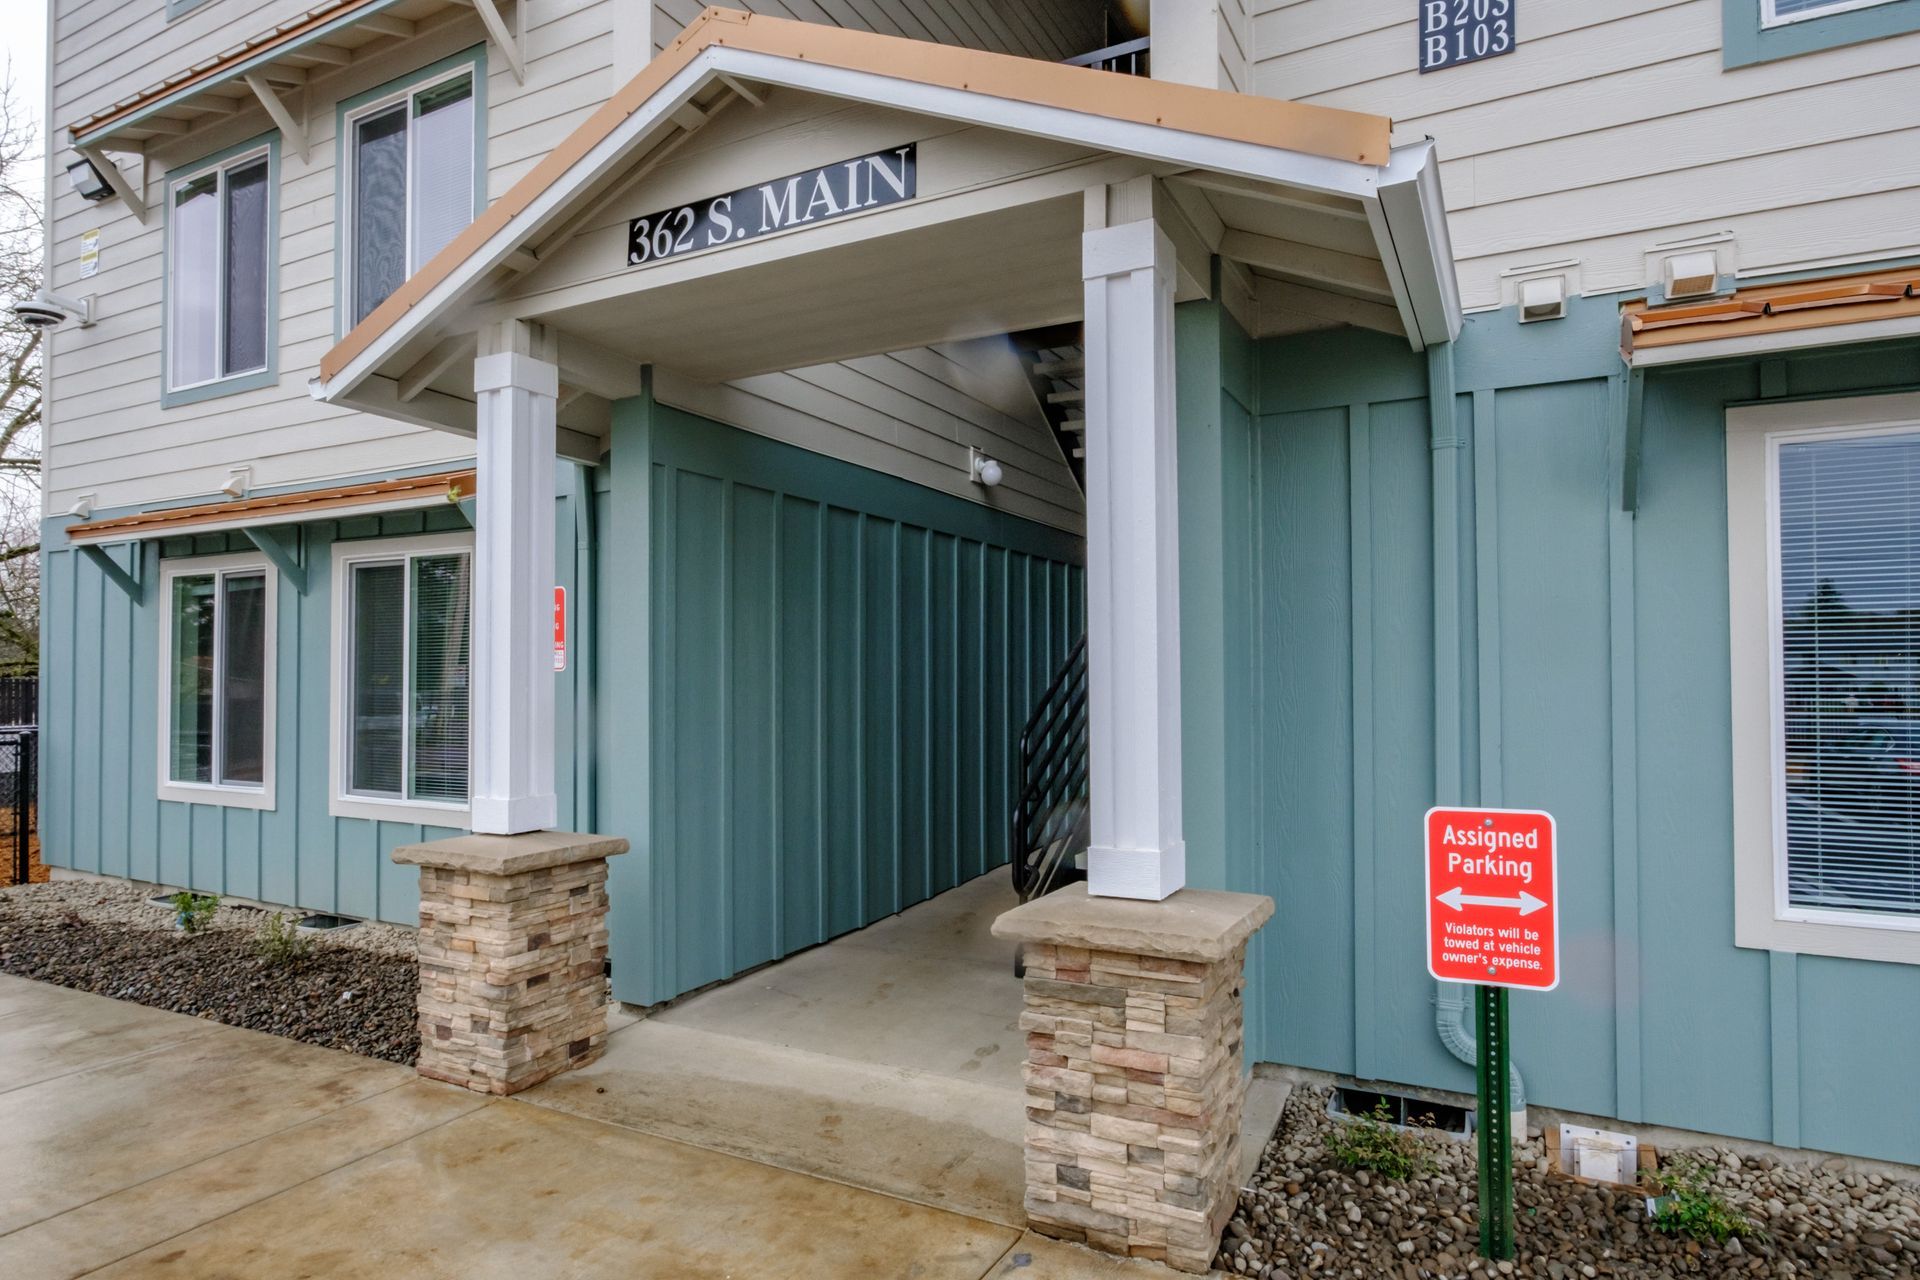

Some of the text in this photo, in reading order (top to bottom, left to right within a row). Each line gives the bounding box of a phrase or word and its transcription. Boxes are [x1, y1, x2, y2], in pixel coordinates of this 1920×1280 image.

[1424, 19, 1510, 68] B103
[630, 147, 910, 264] 362 S. MAIN
[1442, 824, 1538, 853] Assigned
[1448, 852, 1533, 884] Parking
[1445, 922, 1539, 941] Violators will be
[1444, 937, 1541, 956] towed at vehicle
[1442, 952, 1543, 971] owner's expense.
